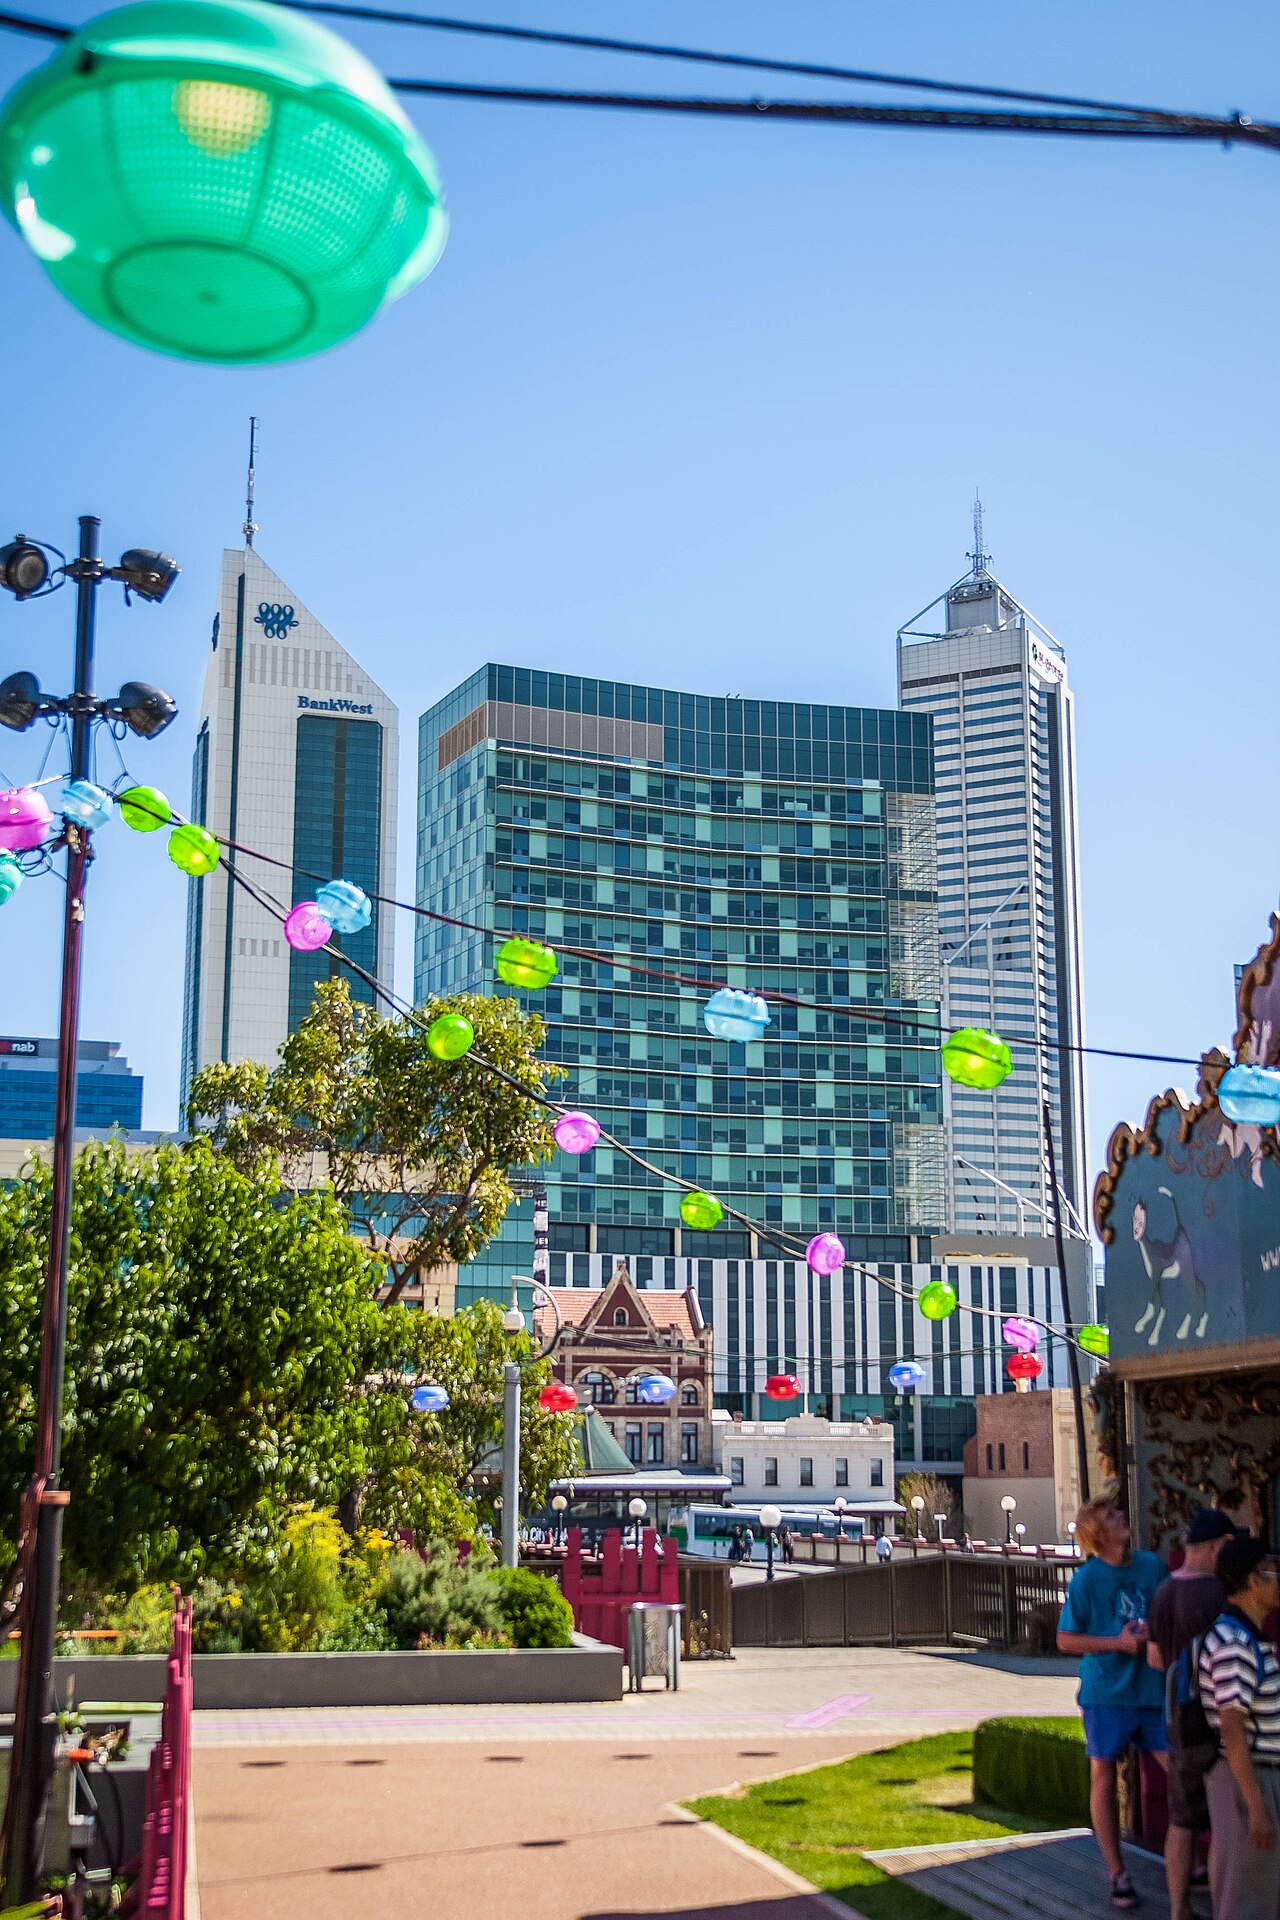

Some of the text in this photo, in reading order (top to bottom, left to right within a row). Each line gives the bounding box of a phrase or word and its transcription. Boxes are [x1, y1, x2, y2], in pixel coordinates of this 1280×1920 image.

[297, 696, 373, 714] BankWest
[11, 1041, 36, 1053] nab
[530, 1526, 545, 1543] City
